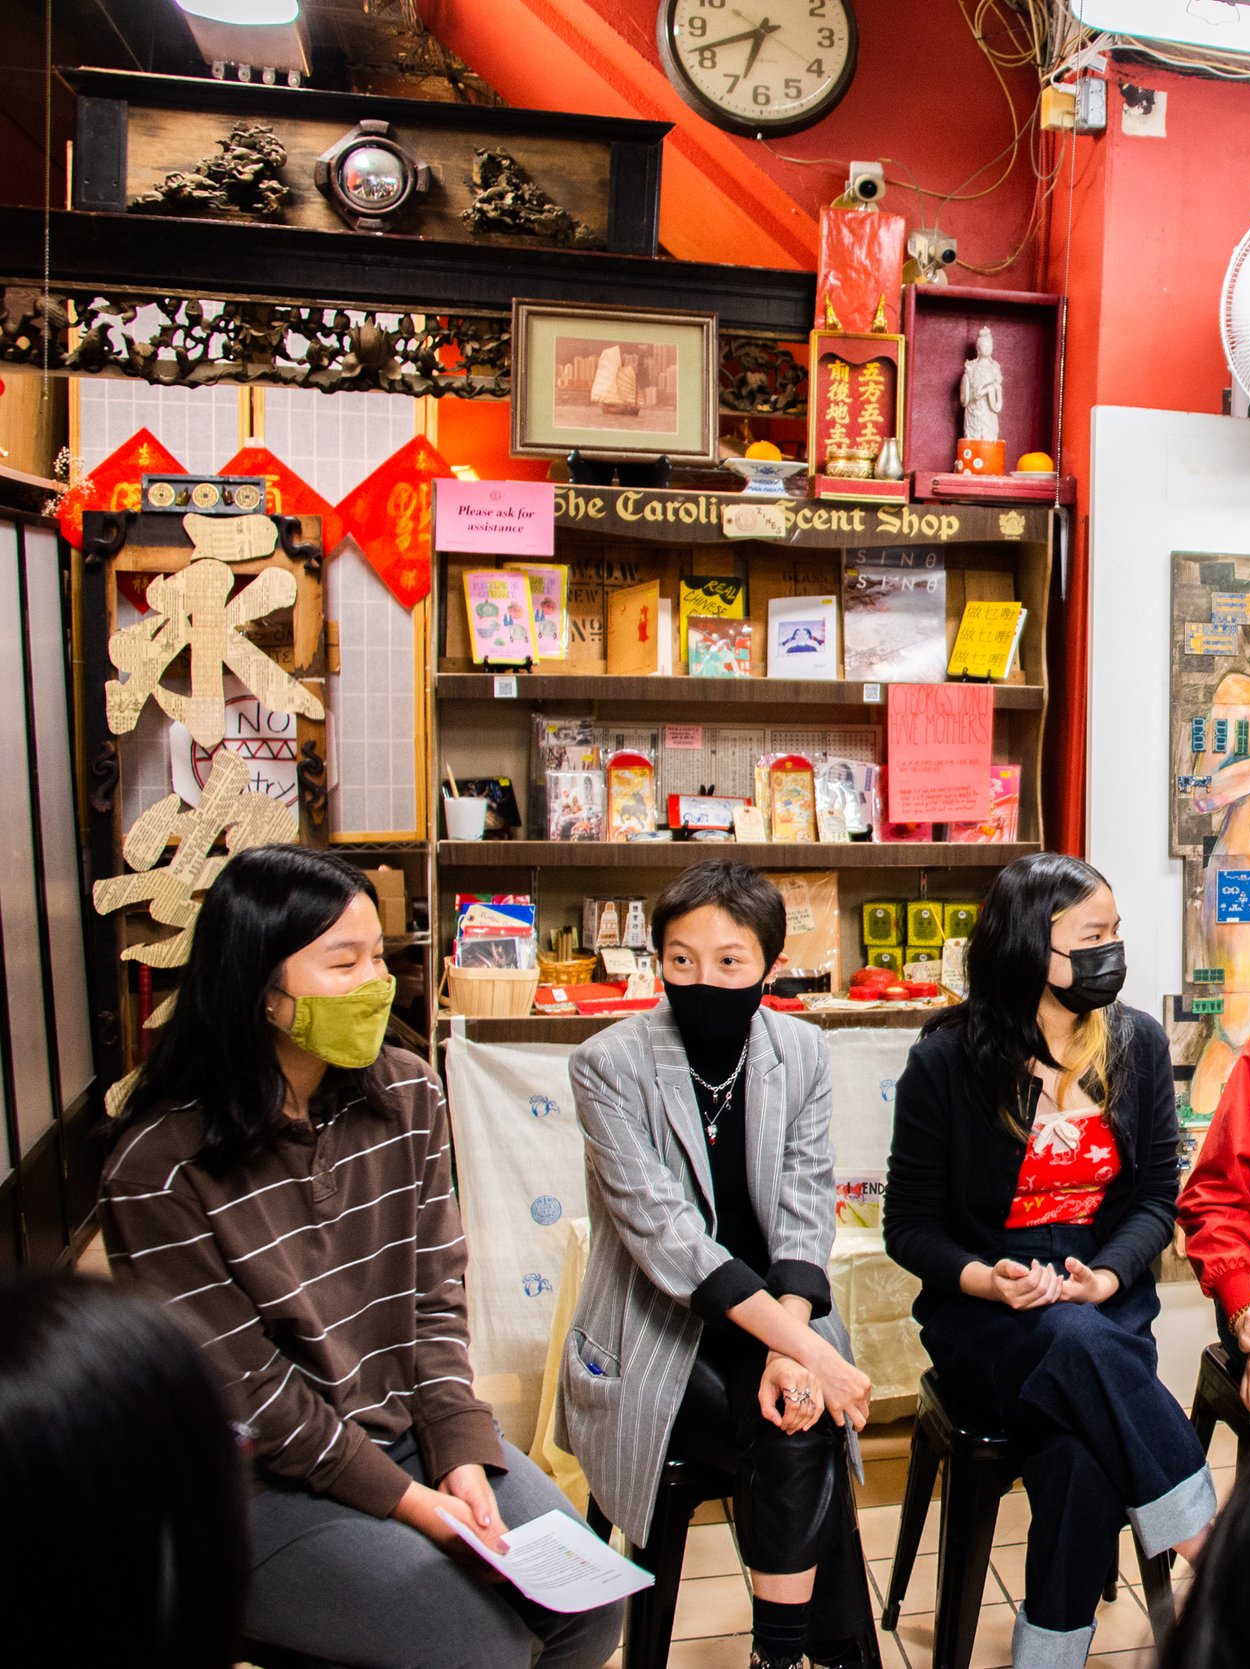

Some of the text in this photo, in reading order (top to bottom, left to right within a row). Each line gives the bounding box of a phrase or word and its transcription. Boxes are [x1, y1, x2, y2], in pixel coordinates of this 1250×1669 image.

[809, 0, 826, 17] 2
[688, 17, 707, 37] 9
[817, 28, 835, 49] 3
[698, 49, 717, 69] 8
[806, 58, 825, 78] 4
[723, 74, 741, 94] 7
[784, 79, 802, 99] 5
[753, 85, 771, 106] 6
[458, 505, 535, 520] Please ask for
[615, 490, 725, 525] Caroli
[775, 498, 866, 533] Scent
[876, 504, 960, 541] Shop
[467, 521, 525, 534] assistance
[703, 580, 737, 600] REAL
[683, 590, 728, 616] CHINESE
[892, 685, 954, 716] CYBORGS
[238, 702, 290, 734] NO
[890, 713, 919, 746] HAVE
[925, 713, 989, 746] MOTHERS
